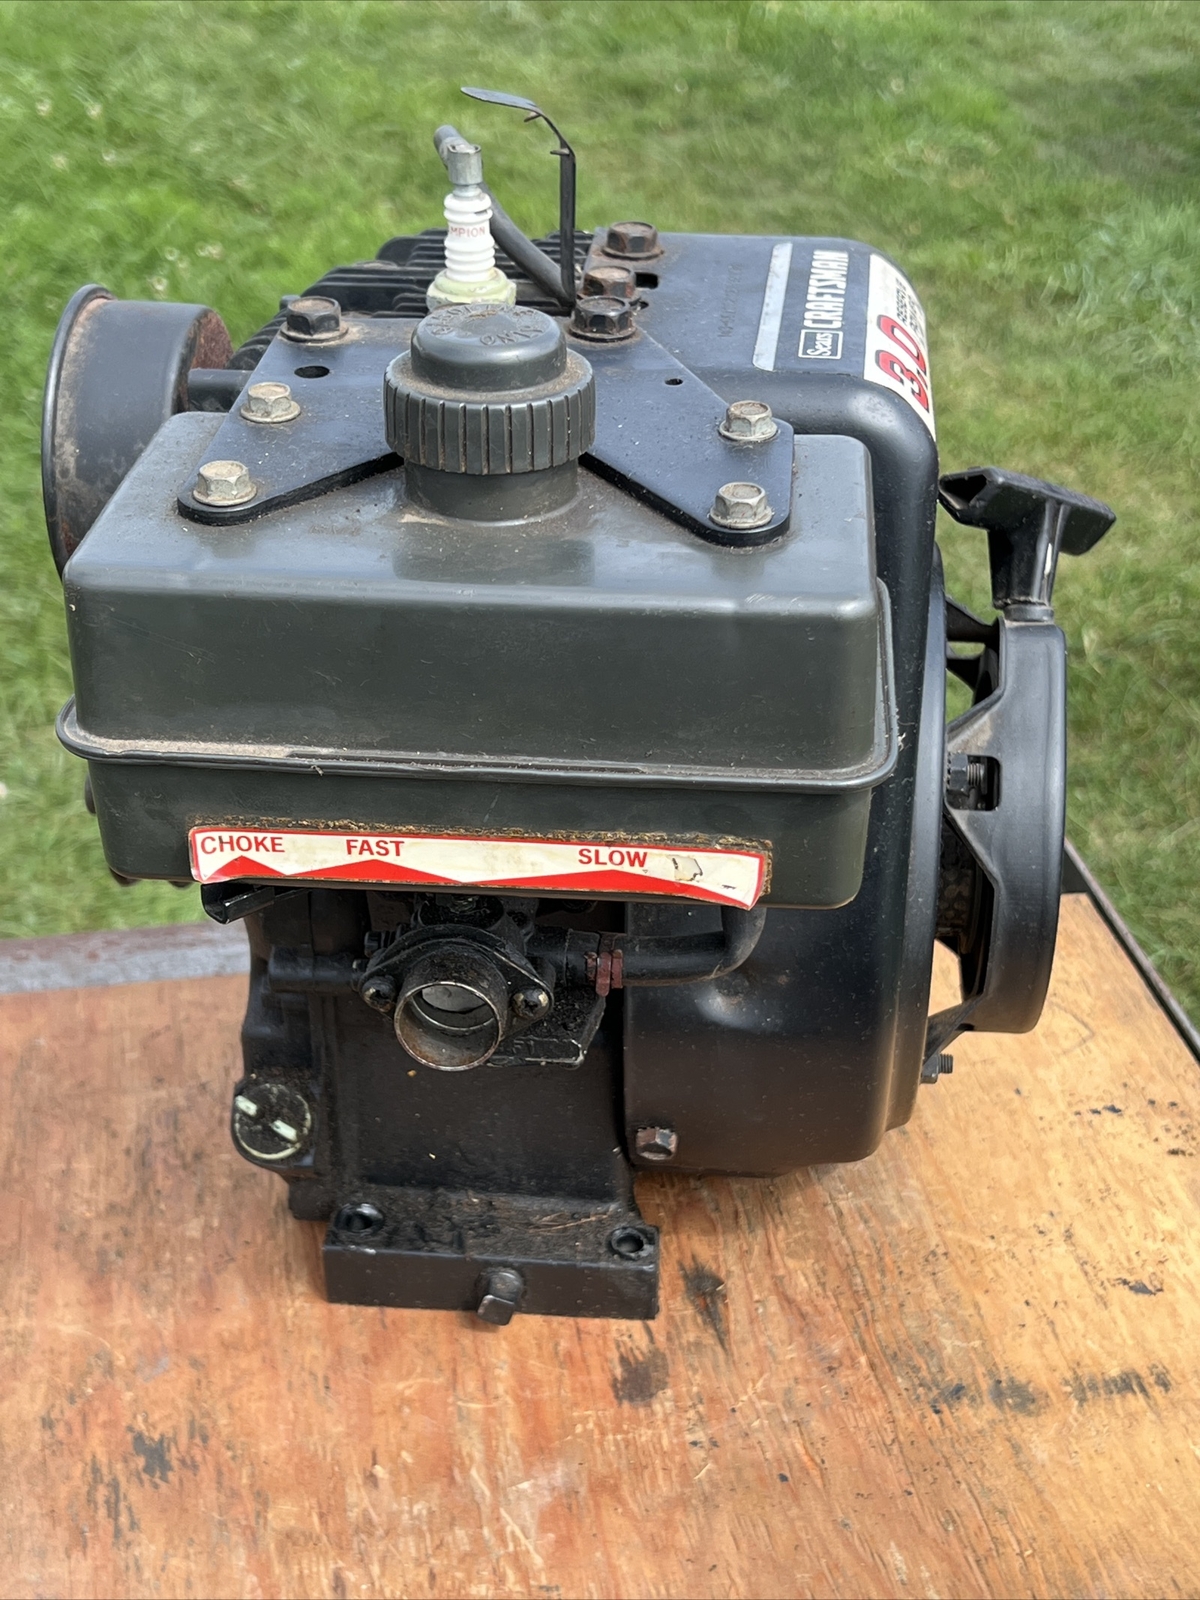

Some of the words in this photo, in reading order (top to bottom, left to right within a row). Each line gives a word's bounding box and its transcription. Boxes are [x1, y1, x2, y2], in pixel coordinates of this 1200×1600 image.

[803, 250, 849, 328] CRAFTSMAN
[808, 333, 834, 357] Sears
[875, 315, 928, 413] 3.0
[200, 835, 285, 854] CHOKE
[346, 839, 405, 857] FAST
[578, 848, 648, 868] SLOW
